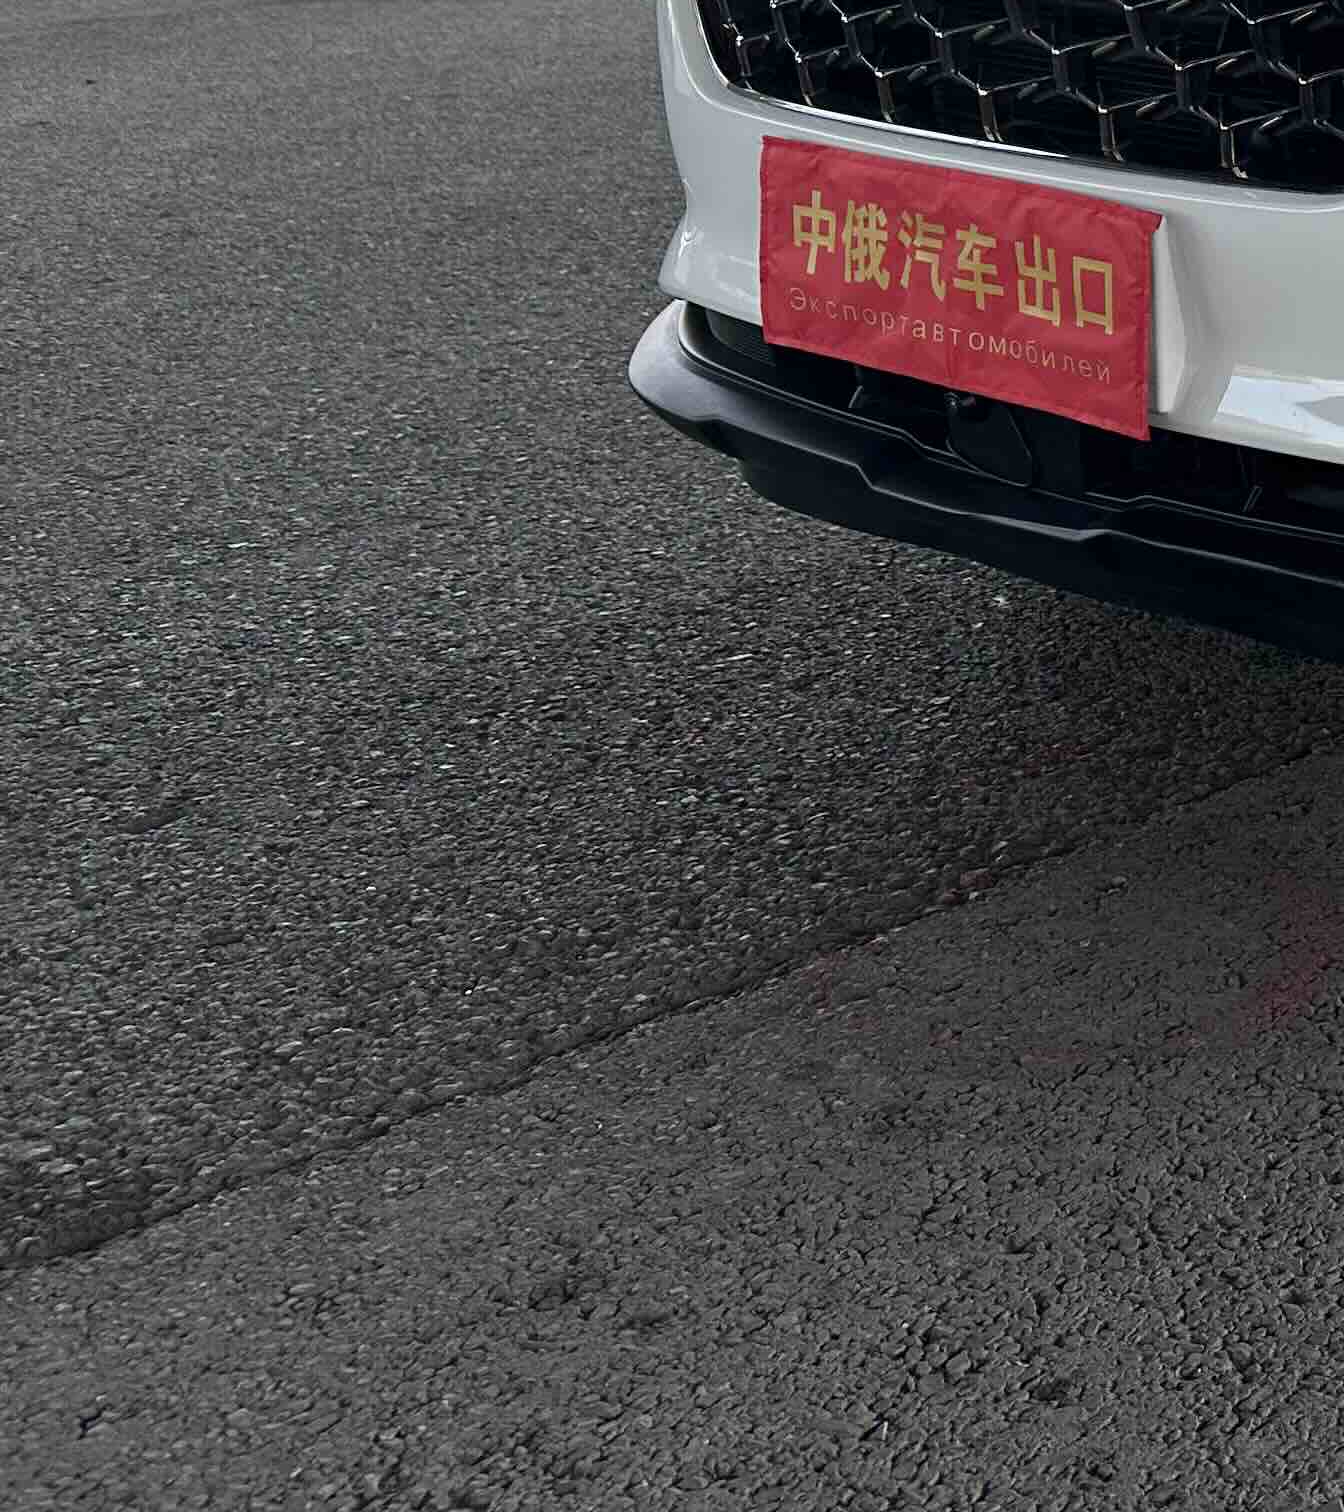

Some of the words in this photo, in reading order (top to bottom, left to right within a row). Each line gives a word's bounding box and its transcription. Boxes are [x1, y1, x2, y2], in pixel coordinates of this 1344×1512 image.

[791, 190, 1114, 336] 中俄汽车出口
[788, 287, 1112, 385] Экспортавтомобилей
